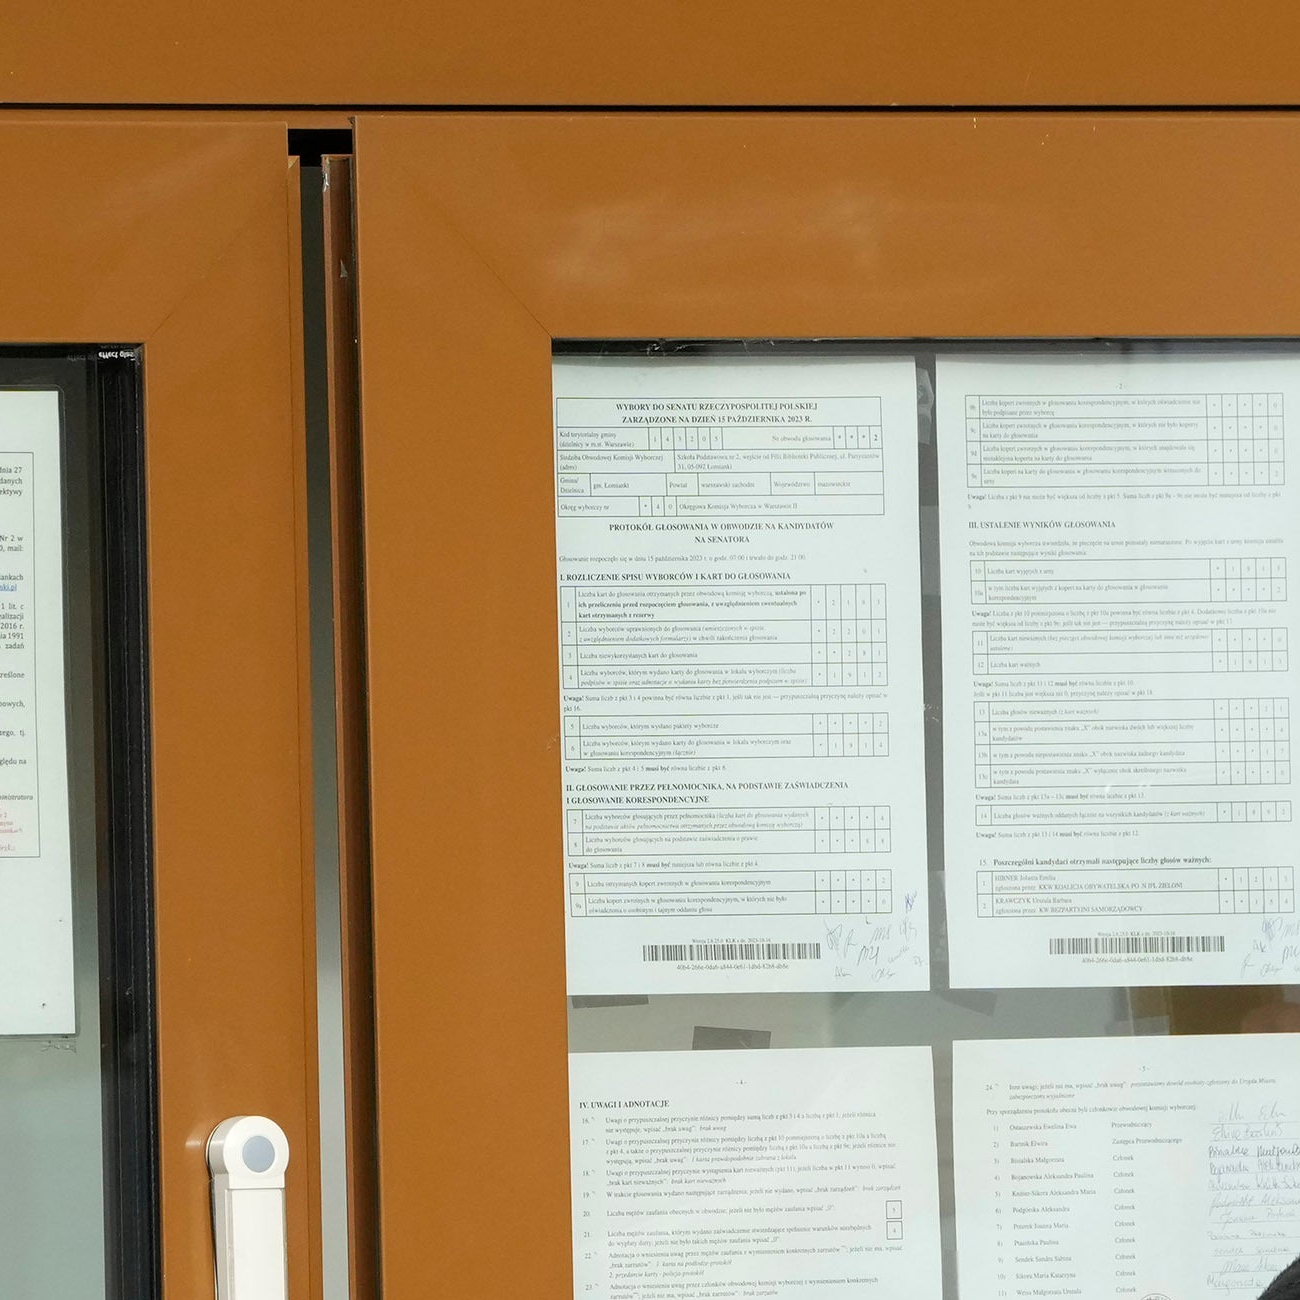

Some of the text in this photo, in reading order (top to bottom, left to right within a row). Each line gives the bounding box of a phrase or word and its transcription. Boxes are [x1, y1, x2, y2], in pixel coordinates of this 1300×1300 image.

[616, 403, 651, 411] WYBORY
[652, 403, 665, 411] DO
[666, 403, 697, 411] SENATU
[699, 403, 778, 411] RZECZYPOSPOLITEJ
[622, 416, 677, 425] ZARZĄDZONE
[691, 414, 716, 423] DZIEŃ
[727, 414, 786, 423] PAŹDZIERNIKA
[788, 415, 803, 423] 2023
[14, 466, 23, 474] 27
[609, 522, 654, 531] PROTOKÓŁ
[655, 523, 709, 531] GŁOSOWANIA
[778, 521, 833, 530] KANDYDATÓW
[968, 521, 979, 529] III.
[980, 521, 1021, 529] USTALENIE
[1022, 520, 1062, 529] WYNIKÓW
[707, 536, 750, 544] SENATORA
[566, 574, 620, 582] ROZLICZENIE
[621, 573, 643, 581] SPISU
[645, 572, 694, 581] WYBORCÓW
[737, 572, 791, 580] GŁOSOWANIA
[566, 784, 575, 792] II.
[575, 784, 628, 792] GŁOSOWANIE
[657, 783, 725, 791] PEŁNOMOCNIKA,
[738, 782, 783, 790] PODSTAWIE
[784, 781, 848, 789] ZAŚWIADCZENIA
[625, 796, 709, 804] KORESPONDENCYJNE
[993, 858, 1035, 867] Poszczególni
[1035, 858, 1069, 867] kandydaci
[1069, 857, 1100, 866] otrzymali
[1101, 857, 1139, 866] następujące
[1140, 856, 1158, 866] liczby
[1160, 856, 1181, 865] głosów
[1183, 856, 1212, 865] ważnych:
[590, 1101, 617, 1109] UWAGI
[623, 1100, 670, 1108] ADNOTACJE
